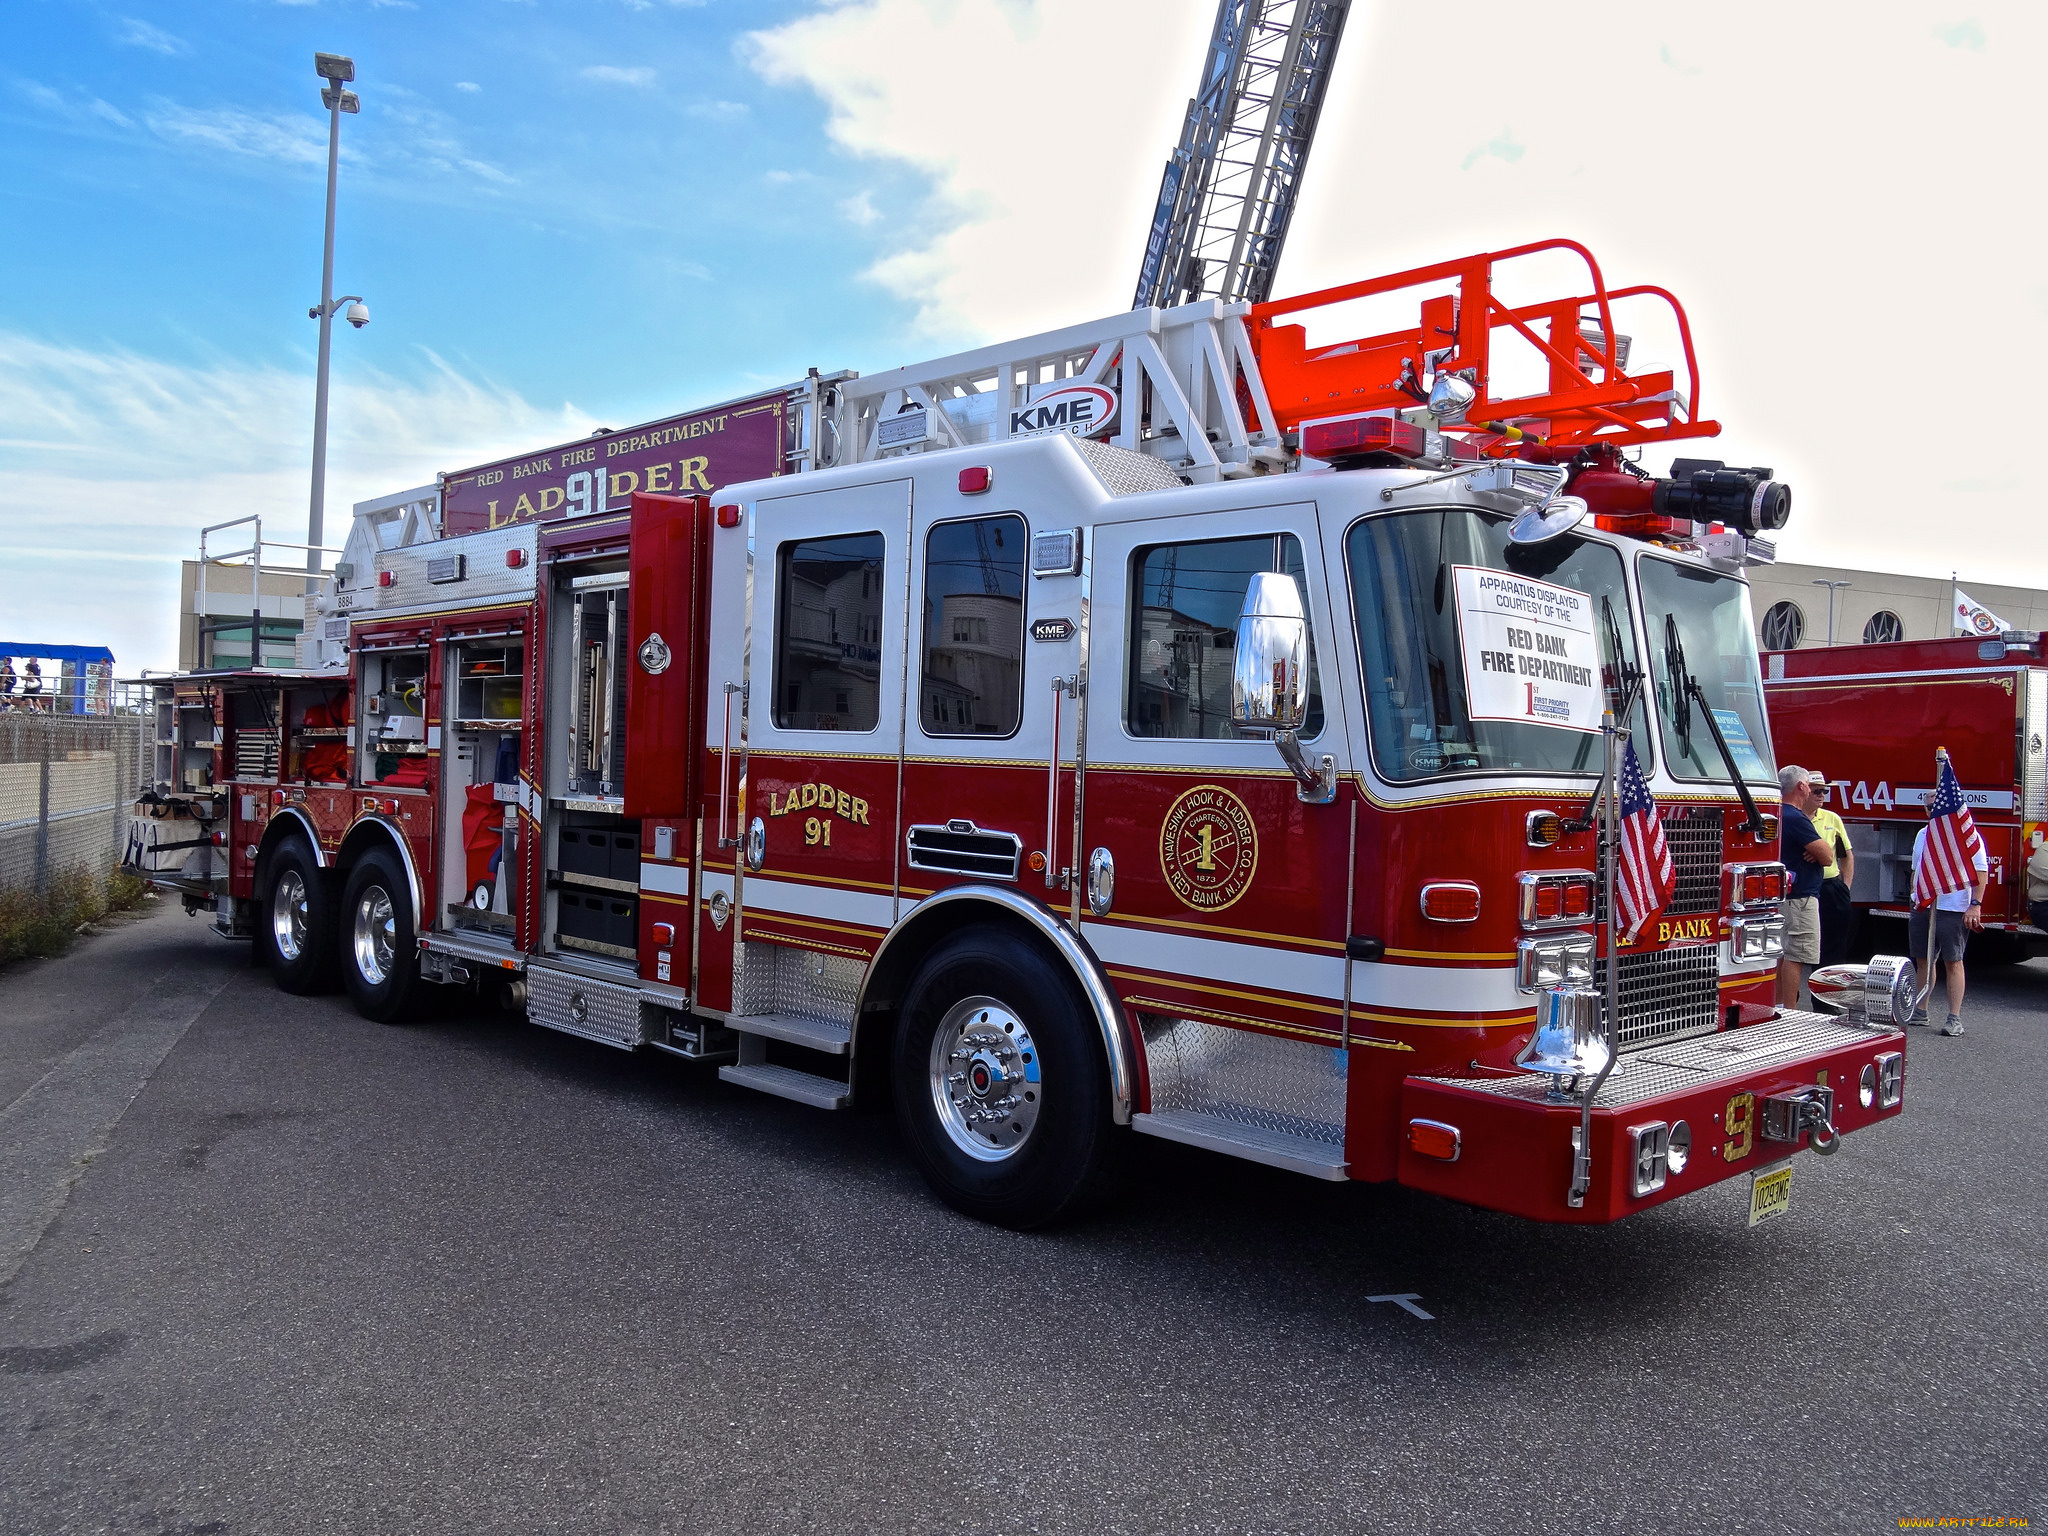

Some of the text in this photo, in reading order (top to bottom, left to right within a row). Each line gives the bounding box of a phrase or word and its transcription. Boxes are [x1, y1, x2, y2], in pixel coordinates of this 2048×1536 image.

[1011, 397, 1093, 433] KME
[477, 415, 729, 487] RED BANK FIRE DEPARTMENT
[488, 455, 715, 530] LADDER
[566, 467, 607, 518] 91
[338, 596, 353, 608] 8884
[1480, 576, 1579, 610] APPARATUS DISPLAYED
[1496, 594, 1571, 622] COURTESY OF THE
[1036, 625, 1064, 634] KME
[1507, 627, 1568, 657] RED BANK
[1480, 651, 1592, 688] FIRE DEPARTMENT
[1534, 696, 1548, 704] FIRST
[770, 782, 870, 826] LADDER
[1831, 780, 1895, 811] T44
[805, 817, 832, 847] 91
[1164, 792, 1252, 868] NAVESINK HOOK & LADDER CO.
[1189, 813, 1228, 831] CHARTERED
[1196, 824, 1216, 870] 1
[1171, 870, 1191, 895] RED
[1658, 918, 1713, 942] BANK
